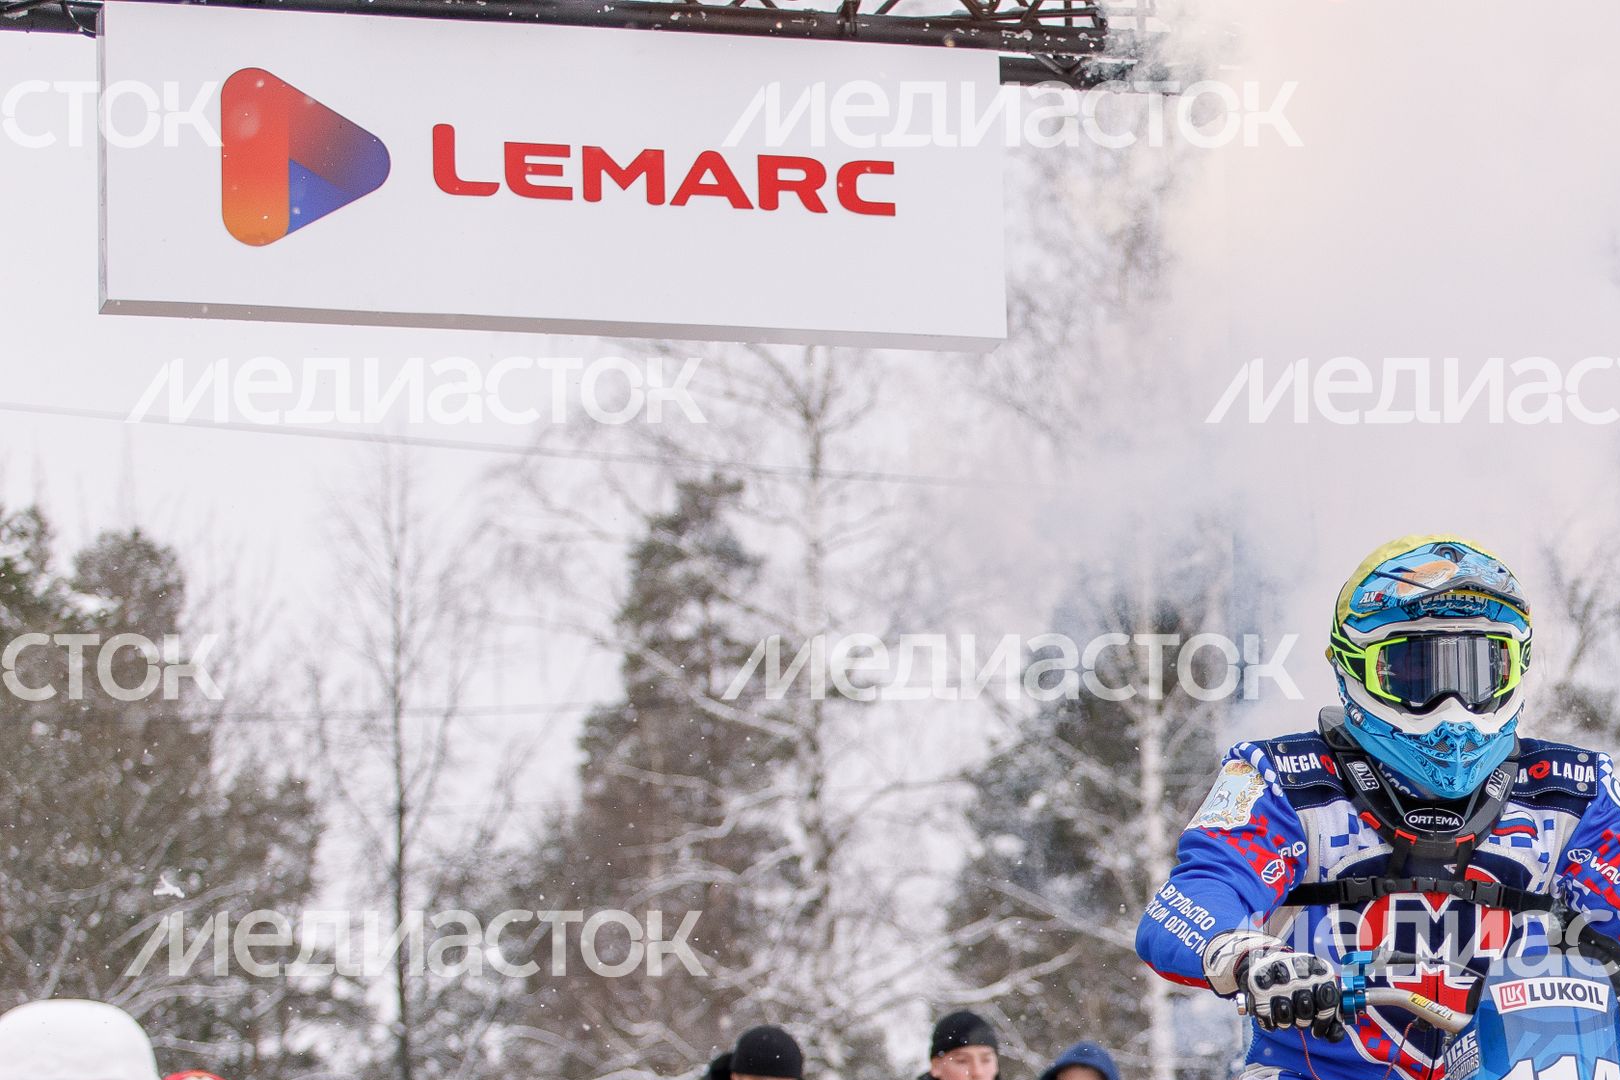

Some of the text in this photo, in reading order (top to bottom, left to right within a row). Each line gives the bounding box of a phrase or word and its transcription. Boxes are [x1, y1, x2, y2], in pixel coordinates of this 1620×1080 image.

[431, 123, 897, 217] LEMARC
[1274, 752, 1322, 774] MEGA
[1552, 760, 1596, 783] LADA
[1408, 814, 1461, 827] ORTEMA
[1528, 982, 1604, 1006] LUKOIL
